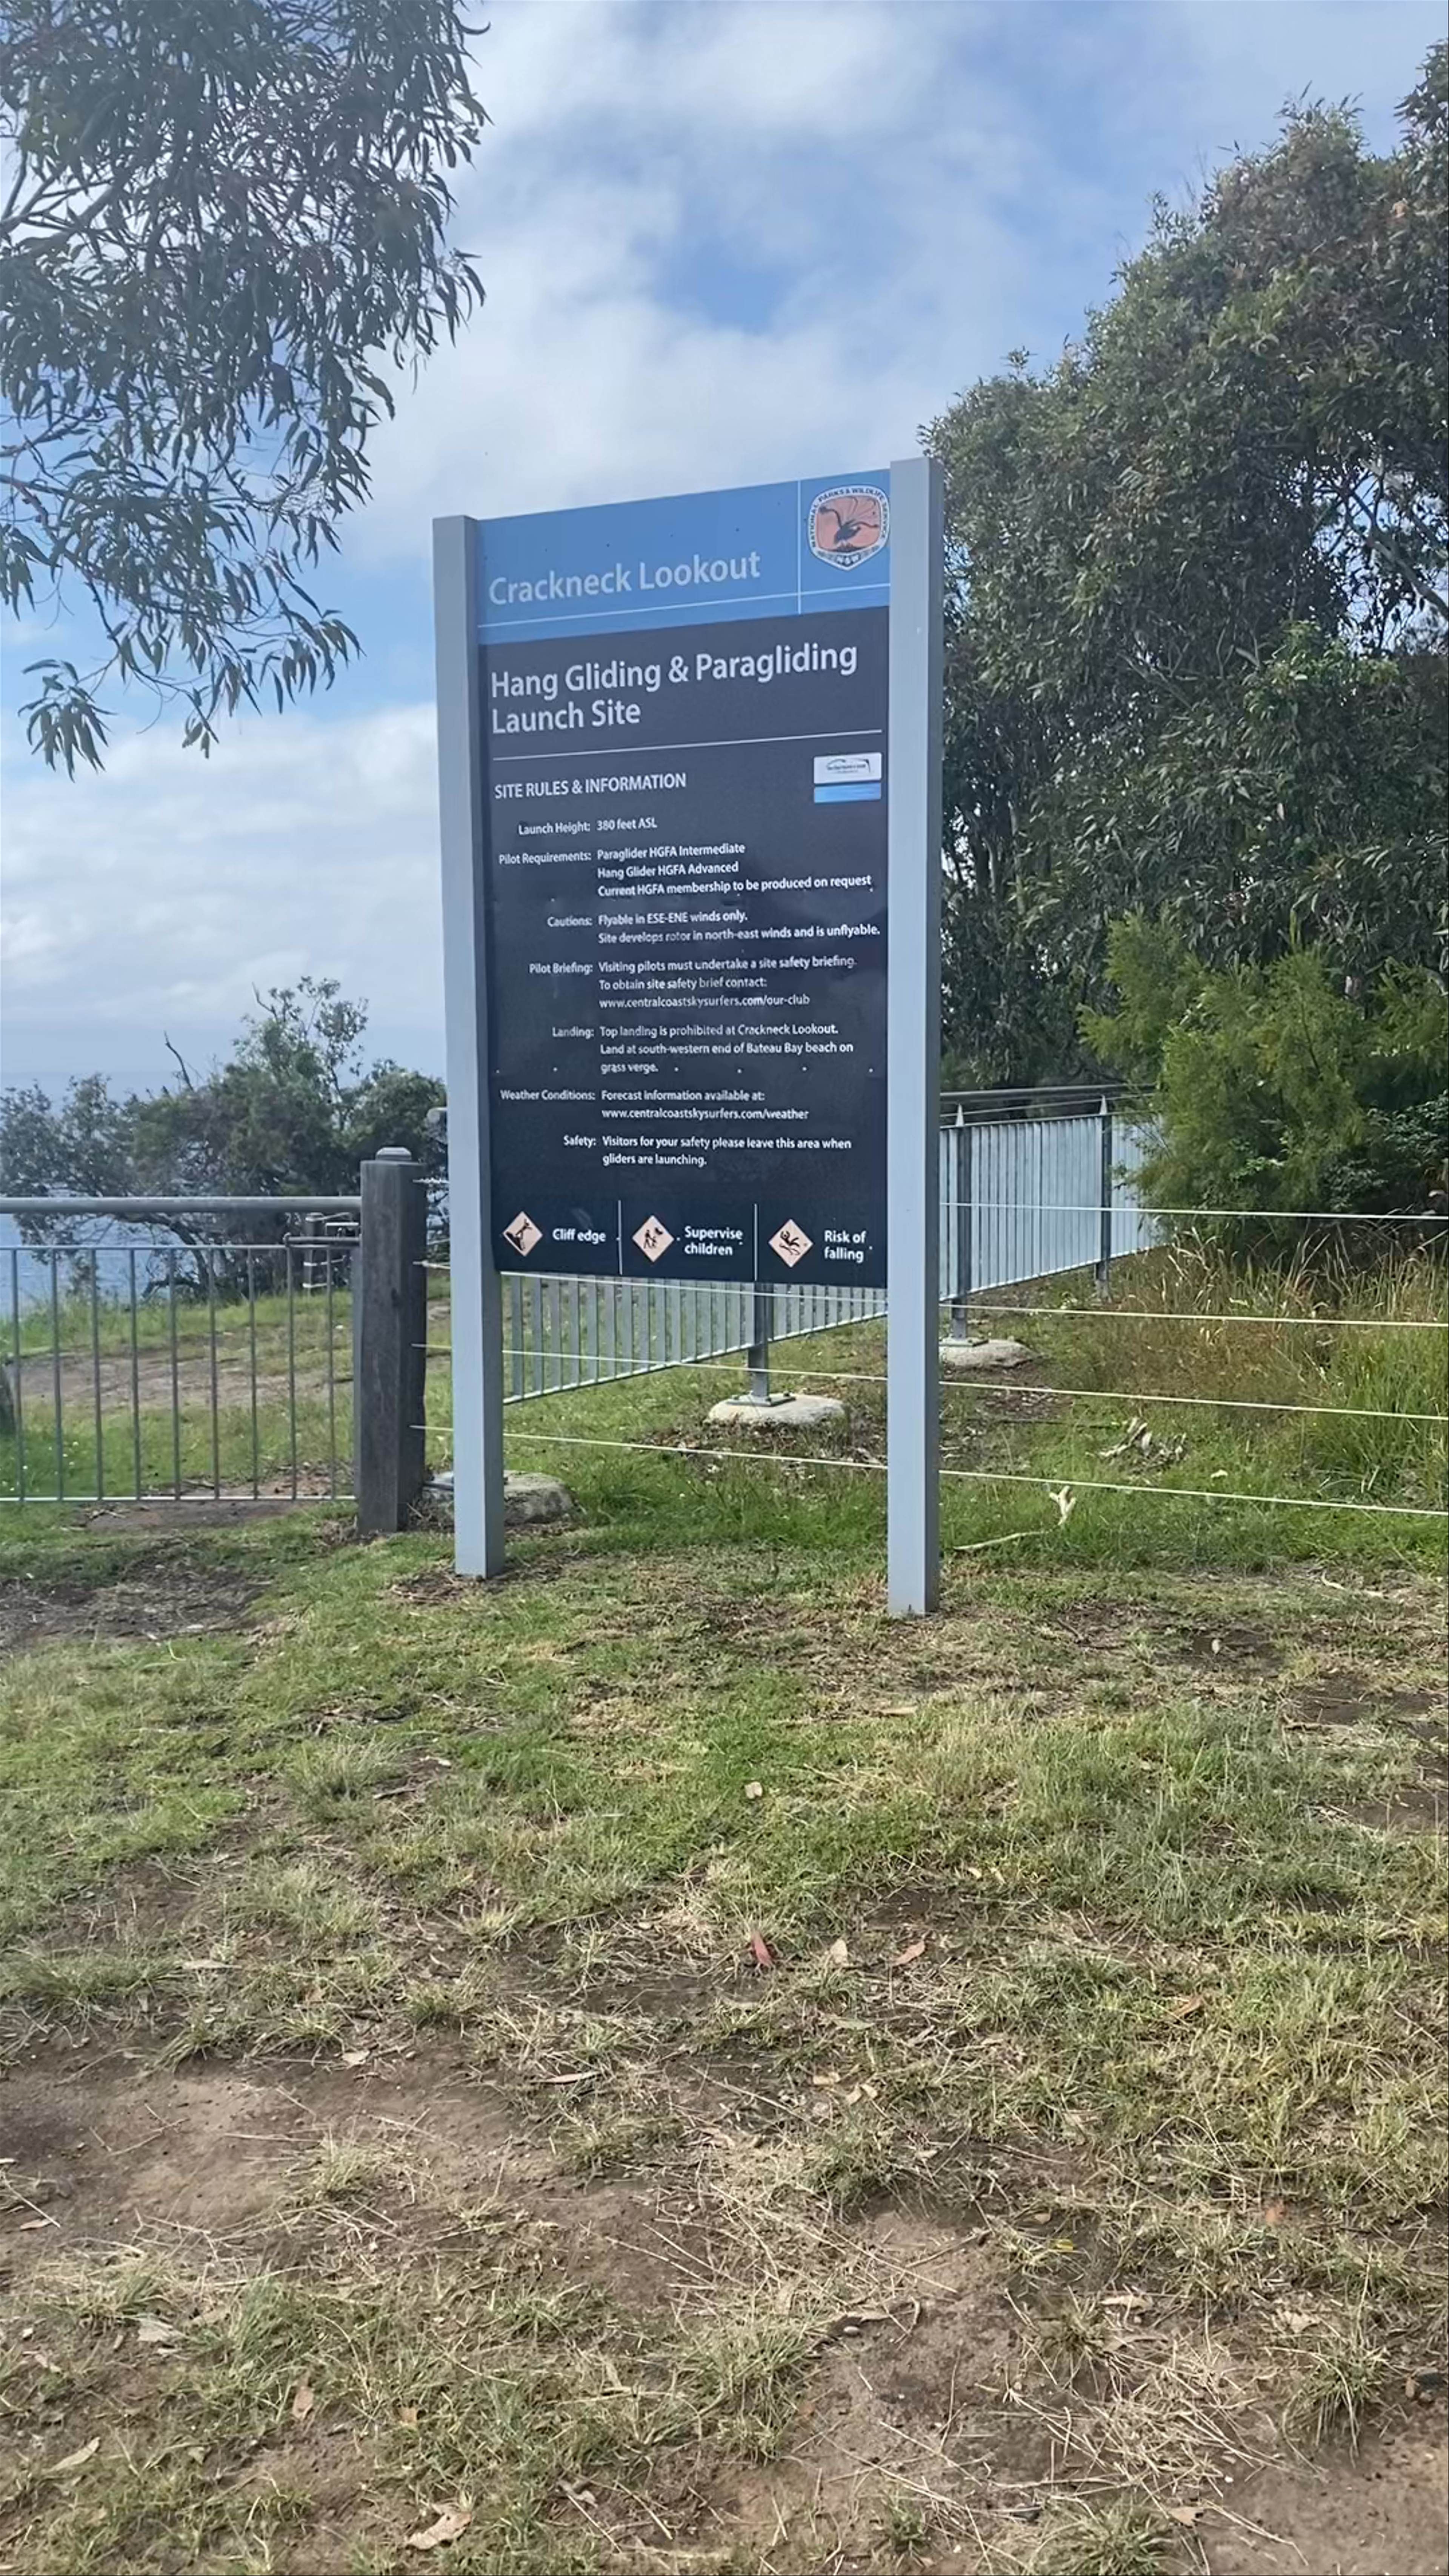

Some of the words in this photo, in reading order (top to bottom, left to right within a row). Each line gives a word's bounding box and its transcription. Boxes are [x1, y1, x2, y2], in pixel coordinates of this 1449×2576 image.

[835, 553, 861, 566] NSW
[489, 563, 632, 604] Crackneck
[640, 551, 760, 590] Lookout
[492, 671, 558, 701] Hang
[565, 660, 660, 692] Gliding
[668, 655, 689, 683] &
[697, 643, 857, 683] Paragliding
[492, 701, 584, 734] Launch
[592, 699, 641, 727] Site
[495, 783, 523, 799] SITE
[526, 780, 569, 797] RULES
[572, 779, 583, 794] &
[585, 773, 686, 793] INFORMATION
[518, 823, 554, 835] Launch
[555, 821, 591, 835] Height:
[597, 819, 615, 831] 380
[617, 818, 637, 829] feet
[638, 817, 657, 828] ASL
[499, 854, 520, 864] Pilot
[522, 851, 592, 865] Requirements:
[597, 847, 648, 862] Paraglider
[649, 846, 677, 858] HGFA
[679, 843, 746, 856] Intermediate
[597, 868, 624, 880] Hang
[626, 865, 656, 877] Glider
[658, 864, 686, 875] HGFA
[688, 861, 738, 874] Advanced
[598, 886, 636, 897] Current
[637, 883, 665, 895] HGFA
[666, 881, 731, 894] membership
[732, 881, 744, 891] to
[746, 879, 759, 890] be
[761, 876, 812, 892] produced
[814, 878, 828, 887] on
[830, 875, 871, 889] request
[598, 914, 634, 927] Flyable
[635, 914, 645, 924] in
[647, 912, 688, 924] ESE-ENE
[690, 910, 721, 922] winds
[722, 909, 748, 923] only.
[598, 933, 617, 944] Site
[618, 931, 663, 944] develops
[665, 932, 691, 941] rotor
[693, 930, 703, 940] in
[705, 928, 759, 940] north-east
[761, 926, 792, 938] winds
[794, 926, 814, 937] and
[816, 926, 825, 937] is
[826, 923, 880, 938] unflyable.
[529, 963, 551, 973] Pilot
[552, 961, 593, 975] Briefing:
[598, 961, 635, 974] Visiting
[637, 960, 666, 974] pilots
[668, 961, 693, 970] must
[694, 958, 748, 970] undertake
[750, 960, 757, 969] a
[759, 958, 777, 969] site
[779, 956, 810, 970] safety
[812, 955, 858, 969] briefing.
[599, 980, 611, 990] To
[612, 979, 645, 990] obtain
[647, 979, 666, 989] site
[667, 977, 697, 990] safety
[699, 976, 724, 988] brief
[725, 977, 767, 988] contact:
[599, 993, 810, 1008] www.centralcoastskysurfers.com/our-club
[552, 1026, 594, 1040] Landing:
[599, 1026, 618, 1039] Top
[620, 1025, 657, 1039] landing
[659, 1026, 668, 1036] is
[669, 1024, 723, 1038] prohibited
[725, 1026, 735, 1035] at
[737, 1024, 790, 1035] Crackneck
[792, 1023, 838, 1034] Lookout.
[600, 1044, 625, 1054] Land
[626, 1044, 637, 1054] at
[638, 1043, 710, 1054] south-western
[711, 1043, 731, 1053] end
[733, 1042, 744, 1053] of
[746, 1043, 782, 1053] Bateau
[784, 1042, 803, 1055] Bay
[805, 1041, 837, 1053] beach
[839, 1044, 854, 1052] on
[600, 1064, 626, 1075] grass
[627, 1064, 658, 1075] verge.
[500, 1089, 540, 1100] Weather
[541, 1089, 595, 1100] Conditions:
[601, 1090, 642, 1100] Forecast
[644, 1089, 702, 1100] information
[704, 1090, 750, 1101] available
[752, 1092, 765, 1101] at:
[601, 1107, 809, 1121] www.centralcoastskysurfers.com/weather
[563, 1135, 596, 1148] Safety:
[602, 1136, 638, 1146] Visitors
[640, 1136, 654, 1146] for
[655, 1138, 678, 1149] your
[680, 1136, 710, 1150] safety
[712, 1137, 745, 1150] please
[747, 1137, 774, 1148] leave
[776, 1137, 795, 1148] this
[797, 1140, 820, 1149] area
[822, 1138, 852, 1149] when
[602, 1153, 636, 1166] gliders
[637, 1156, 653, 1164] are
[655, 1153, 707, 1168] launching.
[552, 1228, 575, 1240] Cliff
[577, 1229, 606, 1244] edge
[685, 1226, 743, 1241] Supervise
[824, 1230, 850, 1243] Risk
[852, 1230, 866, 1243] of
[684, 1242, 733, 1256] children
[824, 1246, 864, 1264] falling
